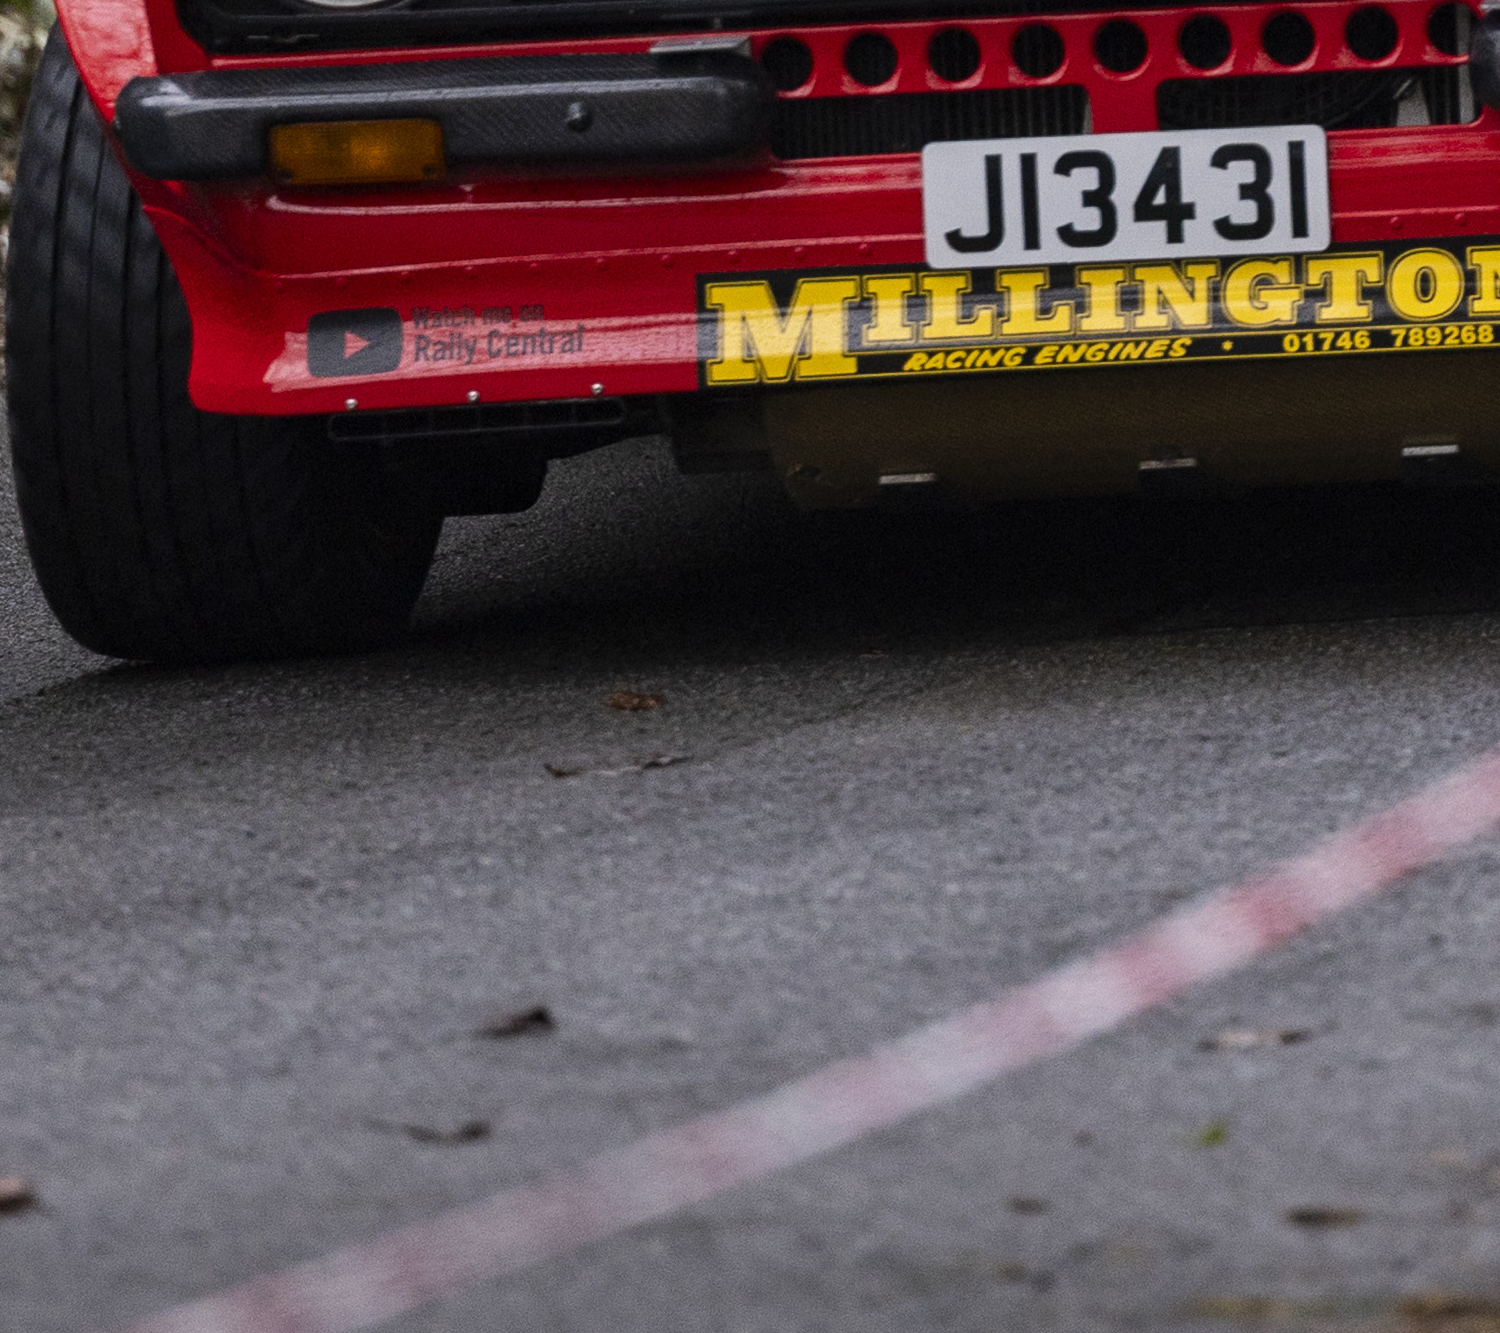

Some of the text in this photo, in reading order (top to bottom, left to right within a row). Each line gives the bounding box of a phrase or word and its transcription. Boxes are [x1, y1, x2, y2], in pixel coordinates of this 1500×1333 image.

[945, 139, 1311, 253] J13431
[411, 305, 476, 329] Watch
[414, 324, 585, 365] Rally Central
[903, 323, 1495, 371] RACING ENGINES 01746 789268
